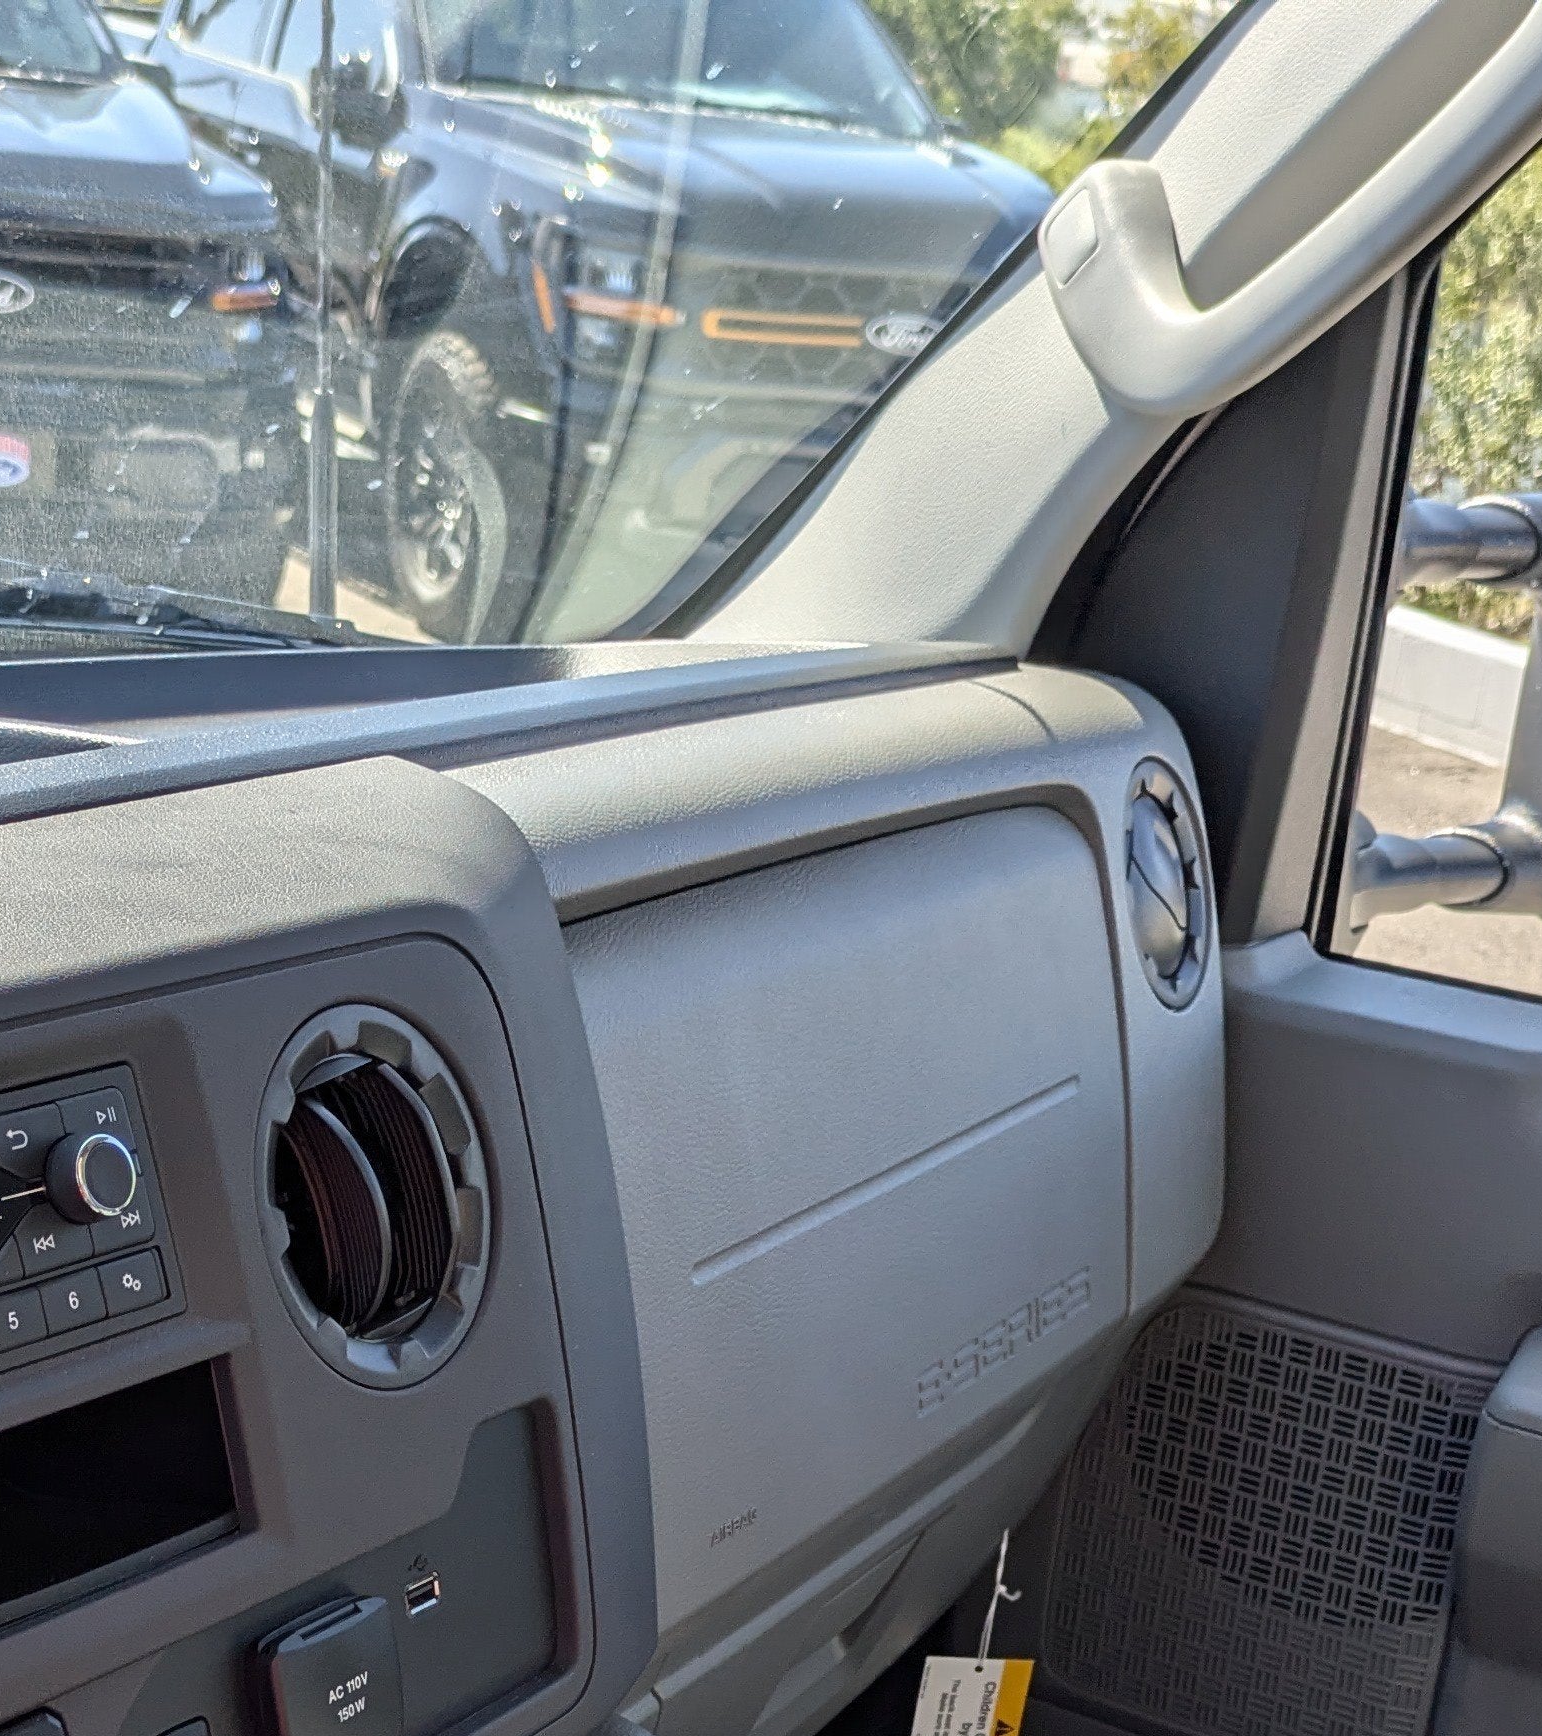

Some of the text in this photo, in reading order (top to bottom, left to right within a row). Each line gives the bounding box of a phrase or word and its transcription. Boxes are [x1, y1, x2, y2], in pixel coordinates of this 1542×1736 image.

[67, 1290, 80, 1310] 6
[8, 1311, 20, 1330] 5
[328, 1670, 368, 1705] AC 110V
[977, 1681, 997, 1731] Children
[958, 1721, 973, 1736] by
